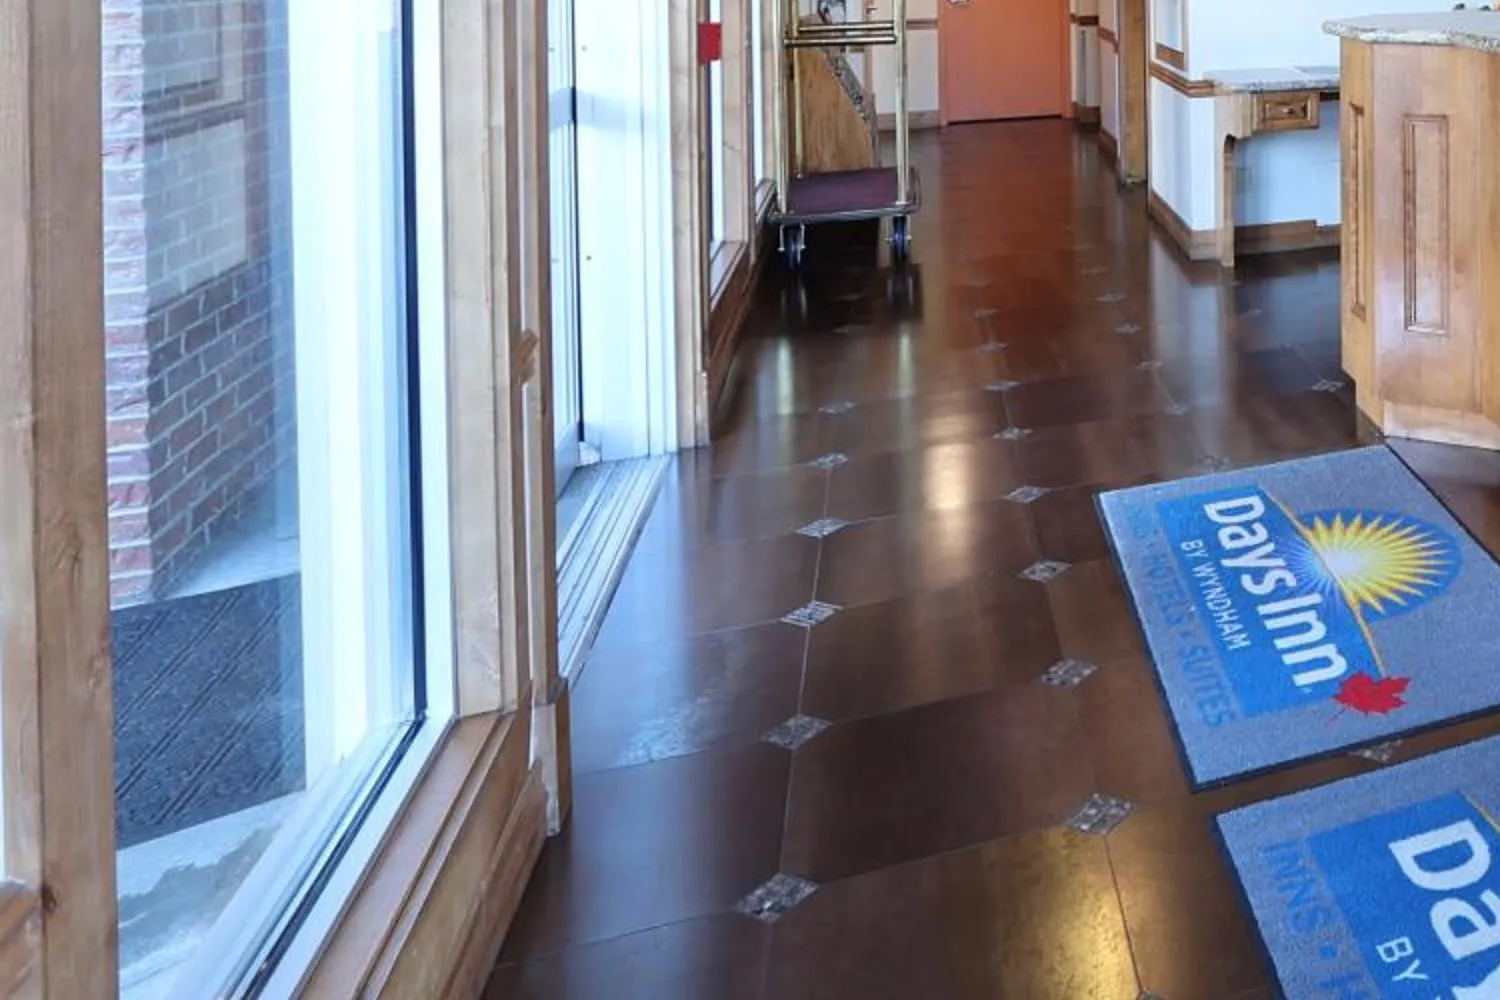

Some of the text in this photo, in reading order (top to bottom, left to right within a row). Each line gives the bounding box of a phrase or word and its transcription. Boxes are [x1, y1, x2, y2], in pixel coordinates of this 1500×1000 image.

[1181, 539, 1252, 650] BY WYNDHAM
[1177, 644, 1234, 727] SUITES
[1260, 838, 1330, 933] INNS
[1376, 936, 1430, 982] BY
